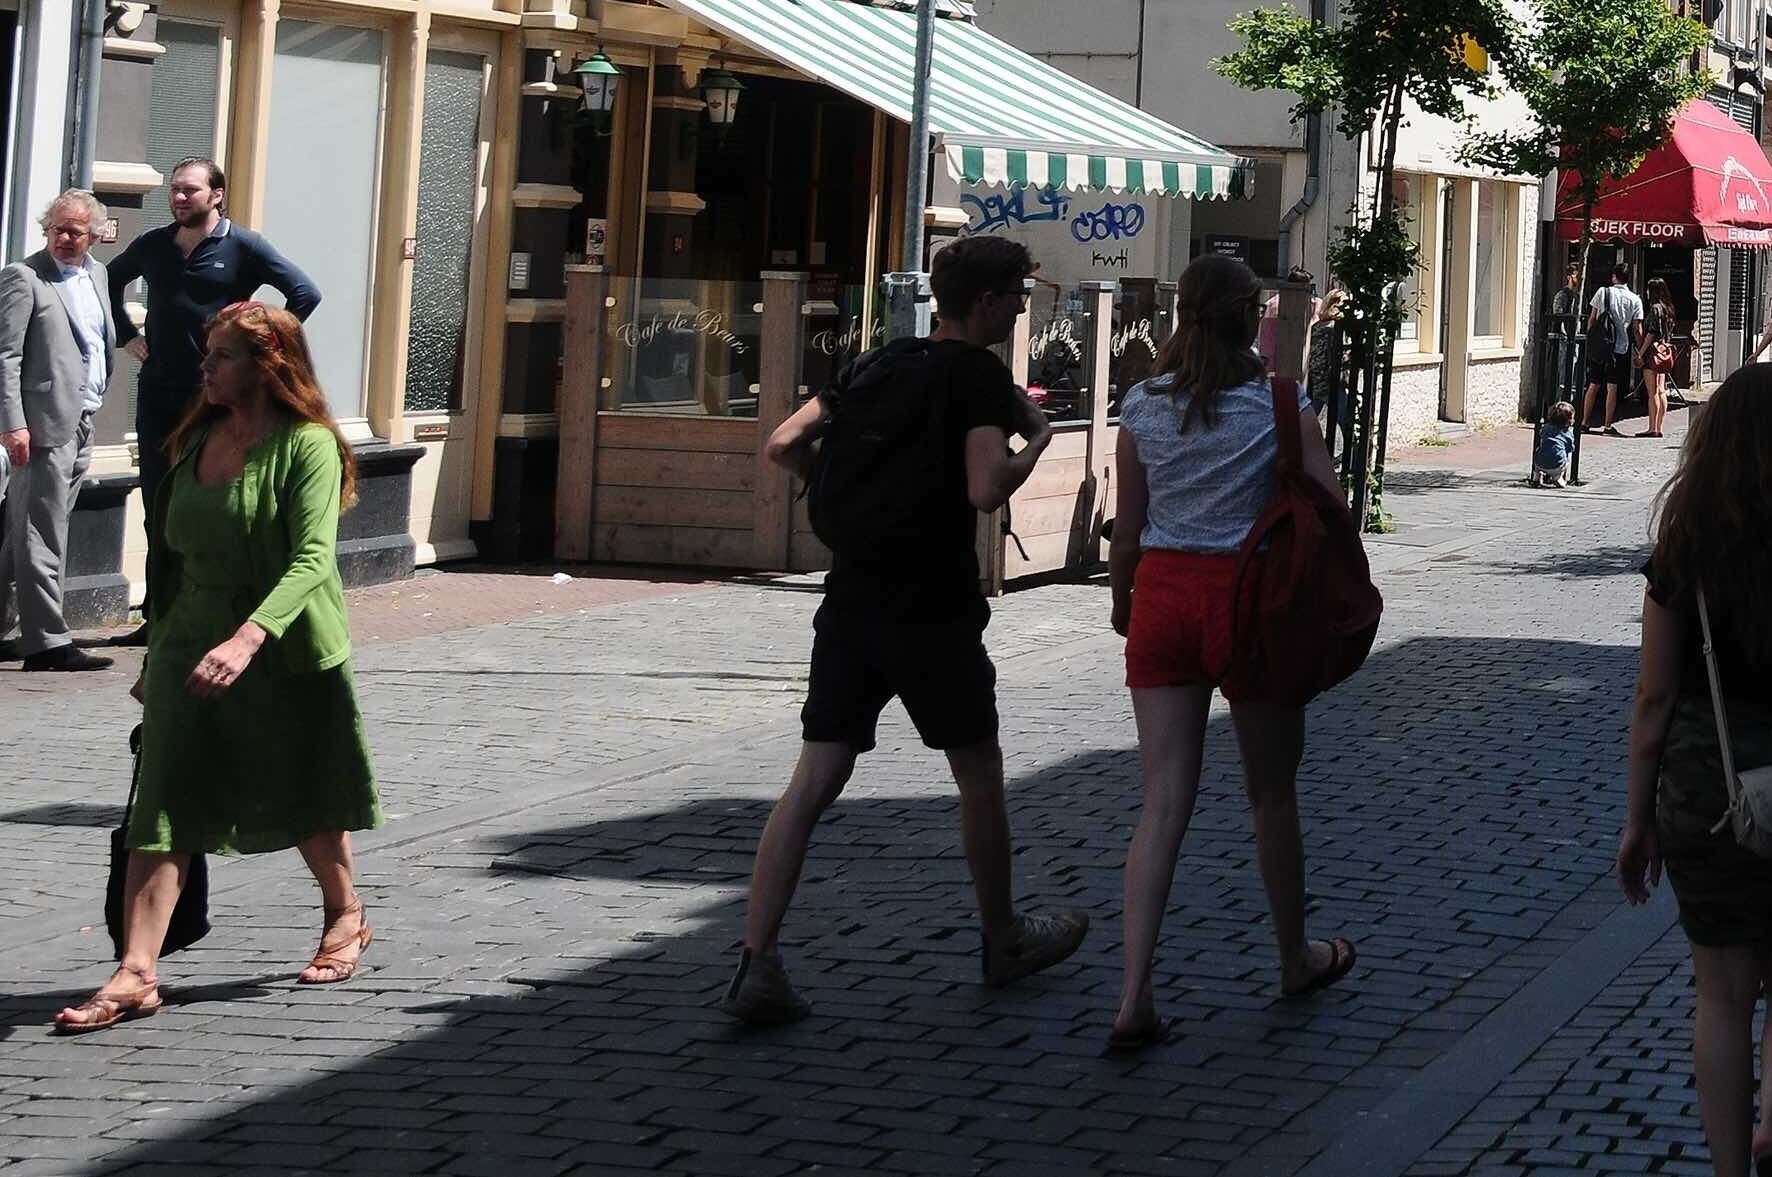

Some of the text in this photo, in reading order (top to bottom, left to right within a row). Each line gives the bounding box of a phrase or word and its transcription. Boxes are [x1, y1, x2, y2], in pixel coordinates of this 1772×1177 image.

[1632, 223, 1685, 238] FLOOR
[667, 311, 688, 330] de
[692, 309, 750, 355] Beurs
